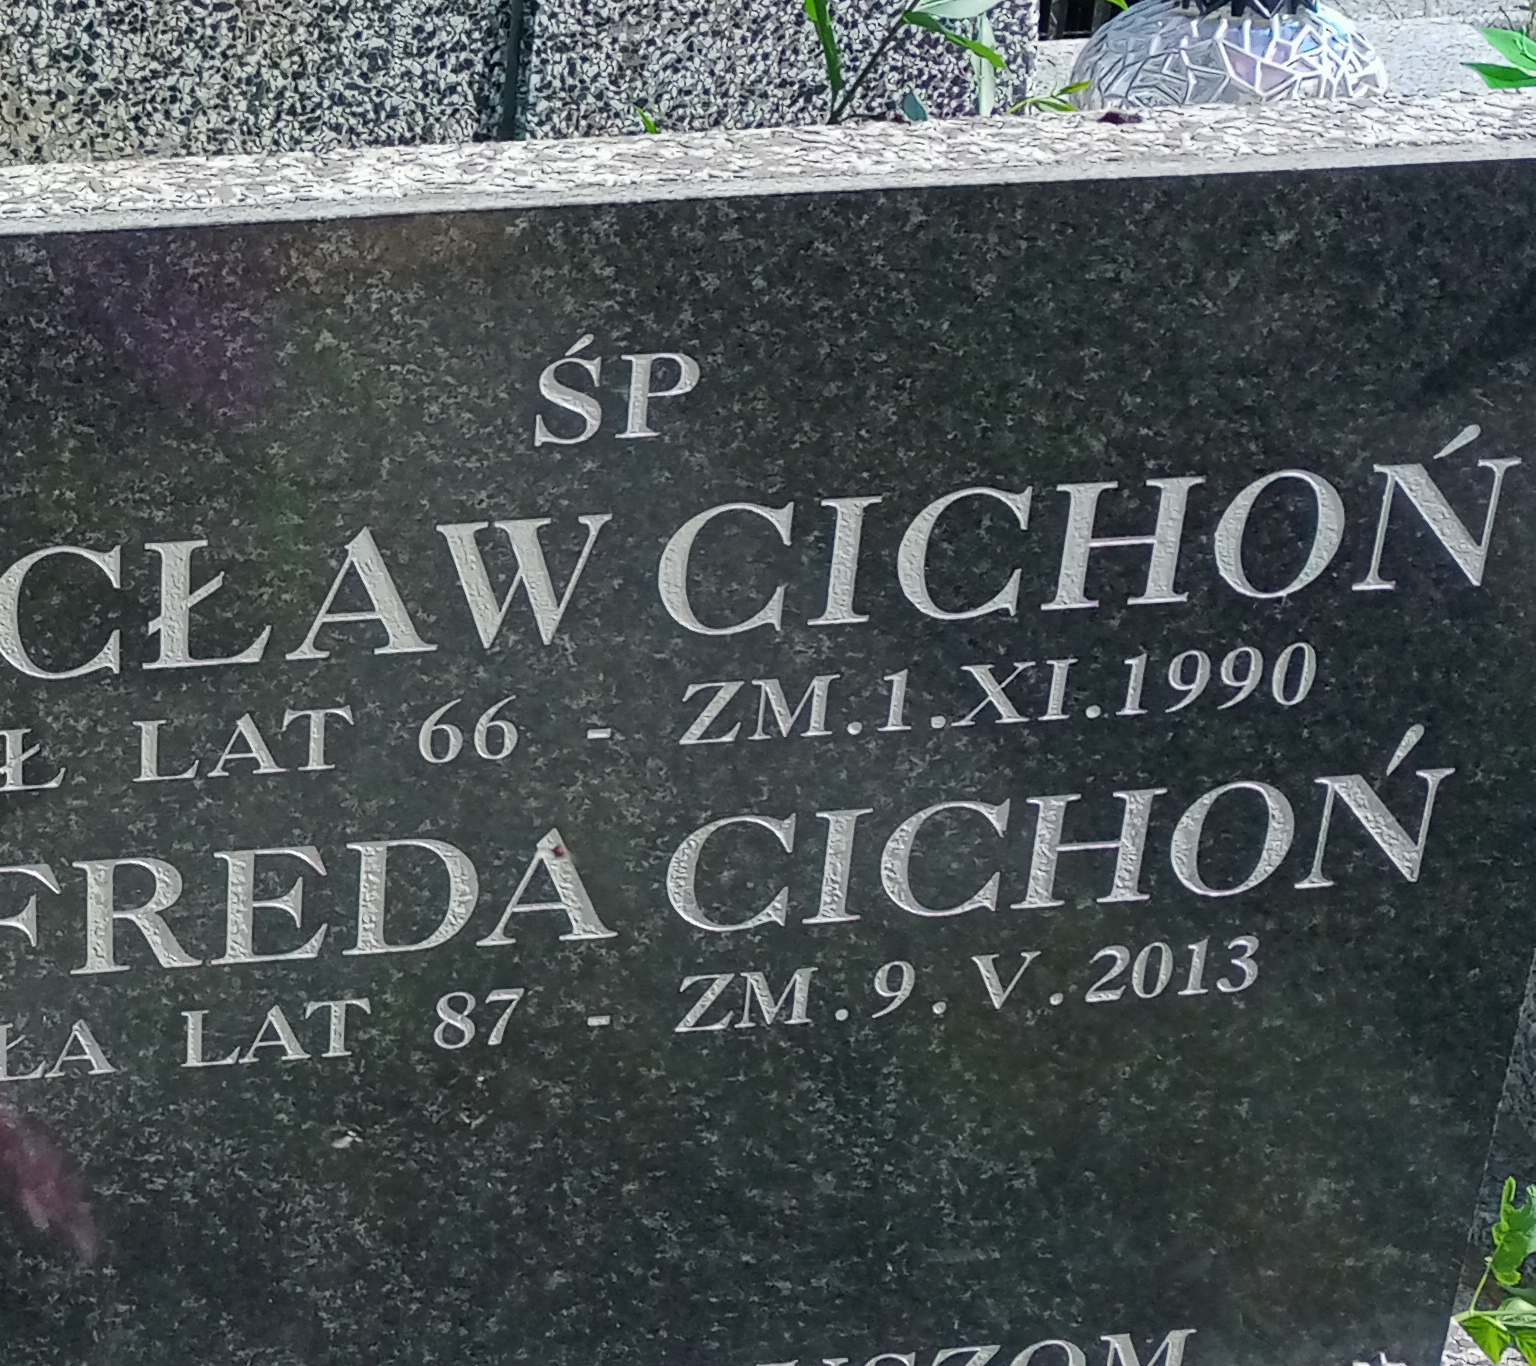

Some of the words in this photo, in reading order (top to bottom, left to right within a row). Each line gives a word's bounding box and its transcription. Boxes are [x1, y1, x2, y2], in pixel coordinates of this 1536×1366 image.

[533, 334, 702, 447] ŚP
[657, 424, 1522, 636] CICHOŃ
[132, 704, 354, 783] LAT
[419, 695, 519, 763] 66
[666, 724, 1457, 933] CICHOŃ
[180, 997, 371, 1069] LAT
[432, 987, 525, 1051] 87
